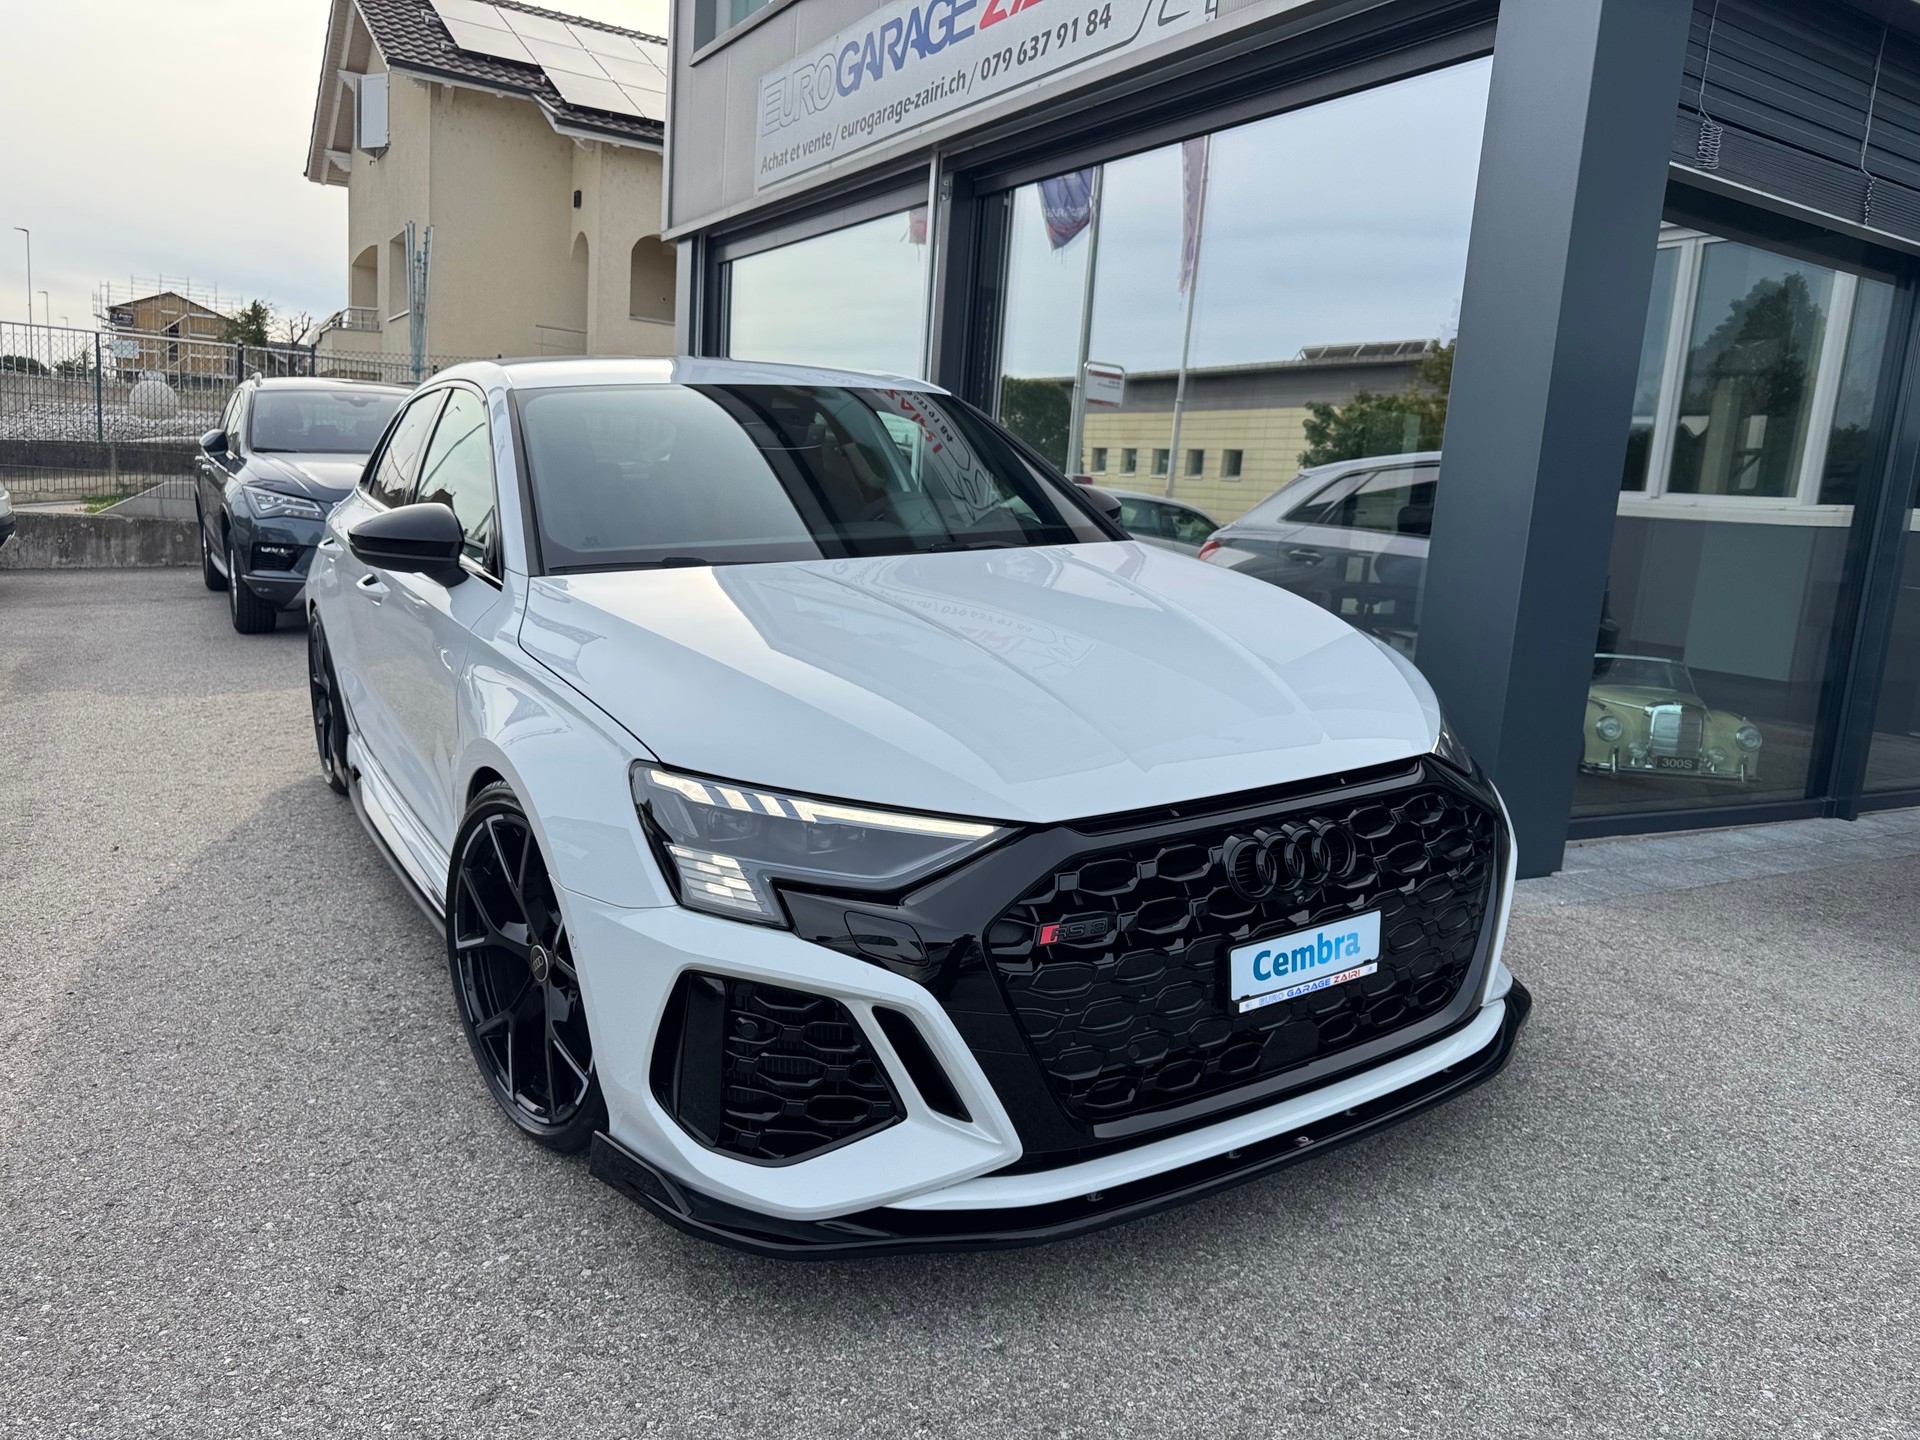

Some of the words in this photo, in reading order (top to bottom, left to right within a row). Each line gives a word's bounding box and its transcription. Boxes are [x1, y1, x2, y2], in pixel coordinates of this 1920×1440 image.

[760, 148, 789, 174] Achat
[790, 143, 801, 162] et
[802, 131, 832, 158] vente
[841, 69, 967, 140] eurogarage-zairi.ch
[980, 47, 1013, 81] 079
[1016, 29, 1052, 66] 637
[1056, 17, 1079, 49] 91
[1086, 2, 1112, 36] 84
[1661, 757, 1693, 769] 300S
[1253, 932, 1361, 982] Cembra
[1258, 992, 1285, 1006] EURO
[1286, 977, 1331, 997] GARAGE
[1333, 969, 1361, 983] ZAIRI
